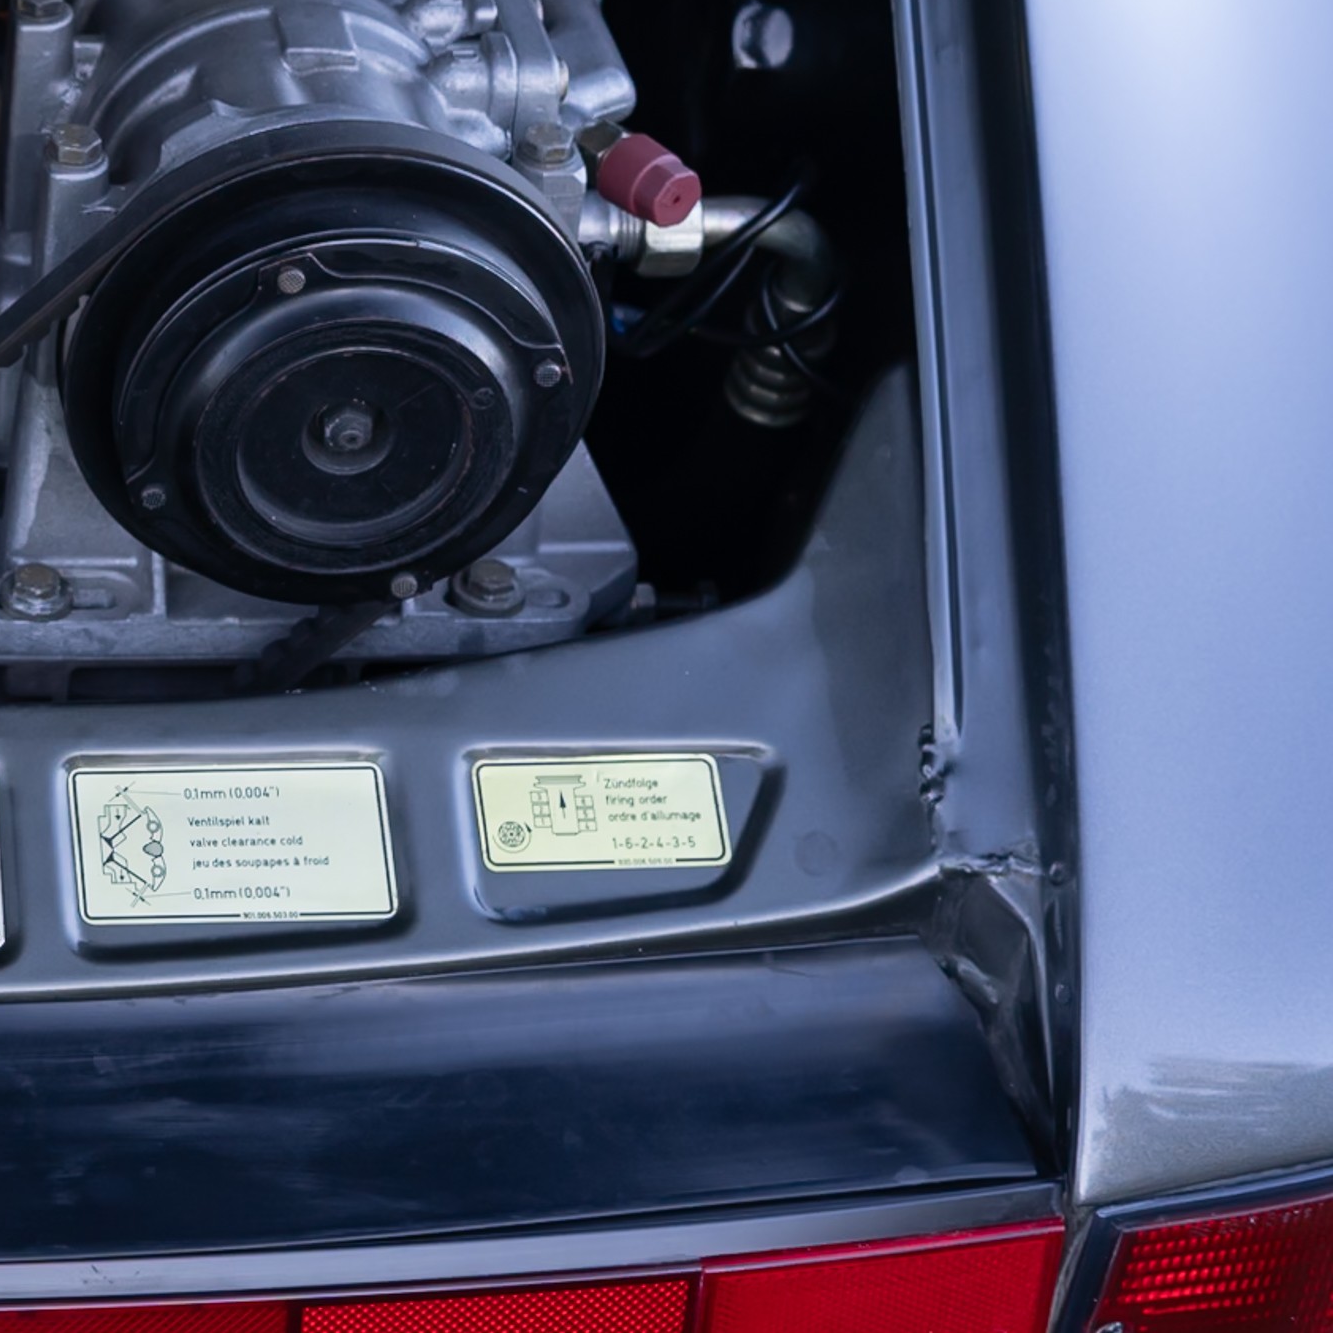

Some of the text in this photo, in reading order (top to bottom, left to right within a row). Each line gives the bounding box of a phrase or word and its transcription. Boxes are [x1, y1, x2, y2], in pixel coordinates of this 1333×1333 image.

[606, 795, 667, 808] firing order
[187, 816, 269, 828] Ventilspiel kalt
[608, 812, 637, 822] ordre
[190, 836, 303, 847] valve clearance cold
[193, 860, 209, 870] jeu
[212, 858, 232, 868] des
[235, 859, 290, 869] soupapes
[304, 856, 329, 865] froid
